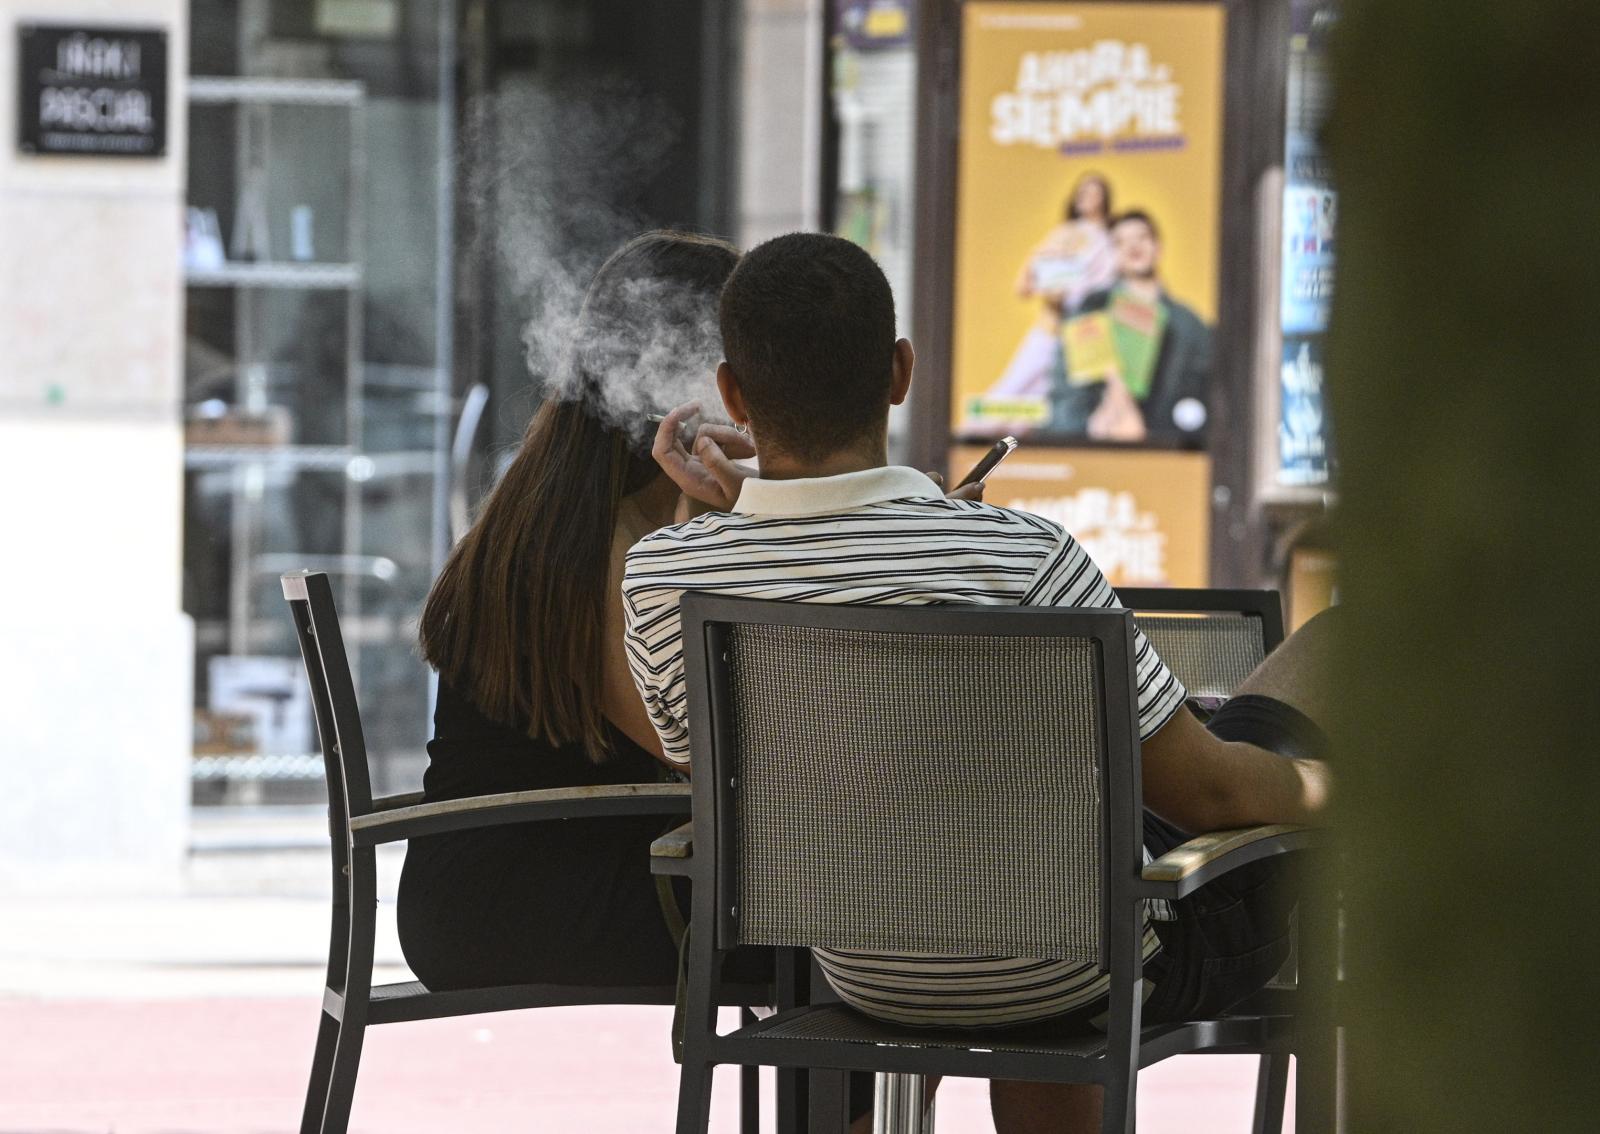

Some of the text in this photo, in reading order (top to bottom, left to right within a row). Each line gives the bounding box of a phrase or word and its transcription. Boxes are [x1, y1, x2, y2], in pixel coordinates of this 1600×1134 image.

[1017, 40, 1150, 92] AHORA
[40, 87, 153, 132] PASCUAL
[991, 82, 1180, 147] SIEMPRE
